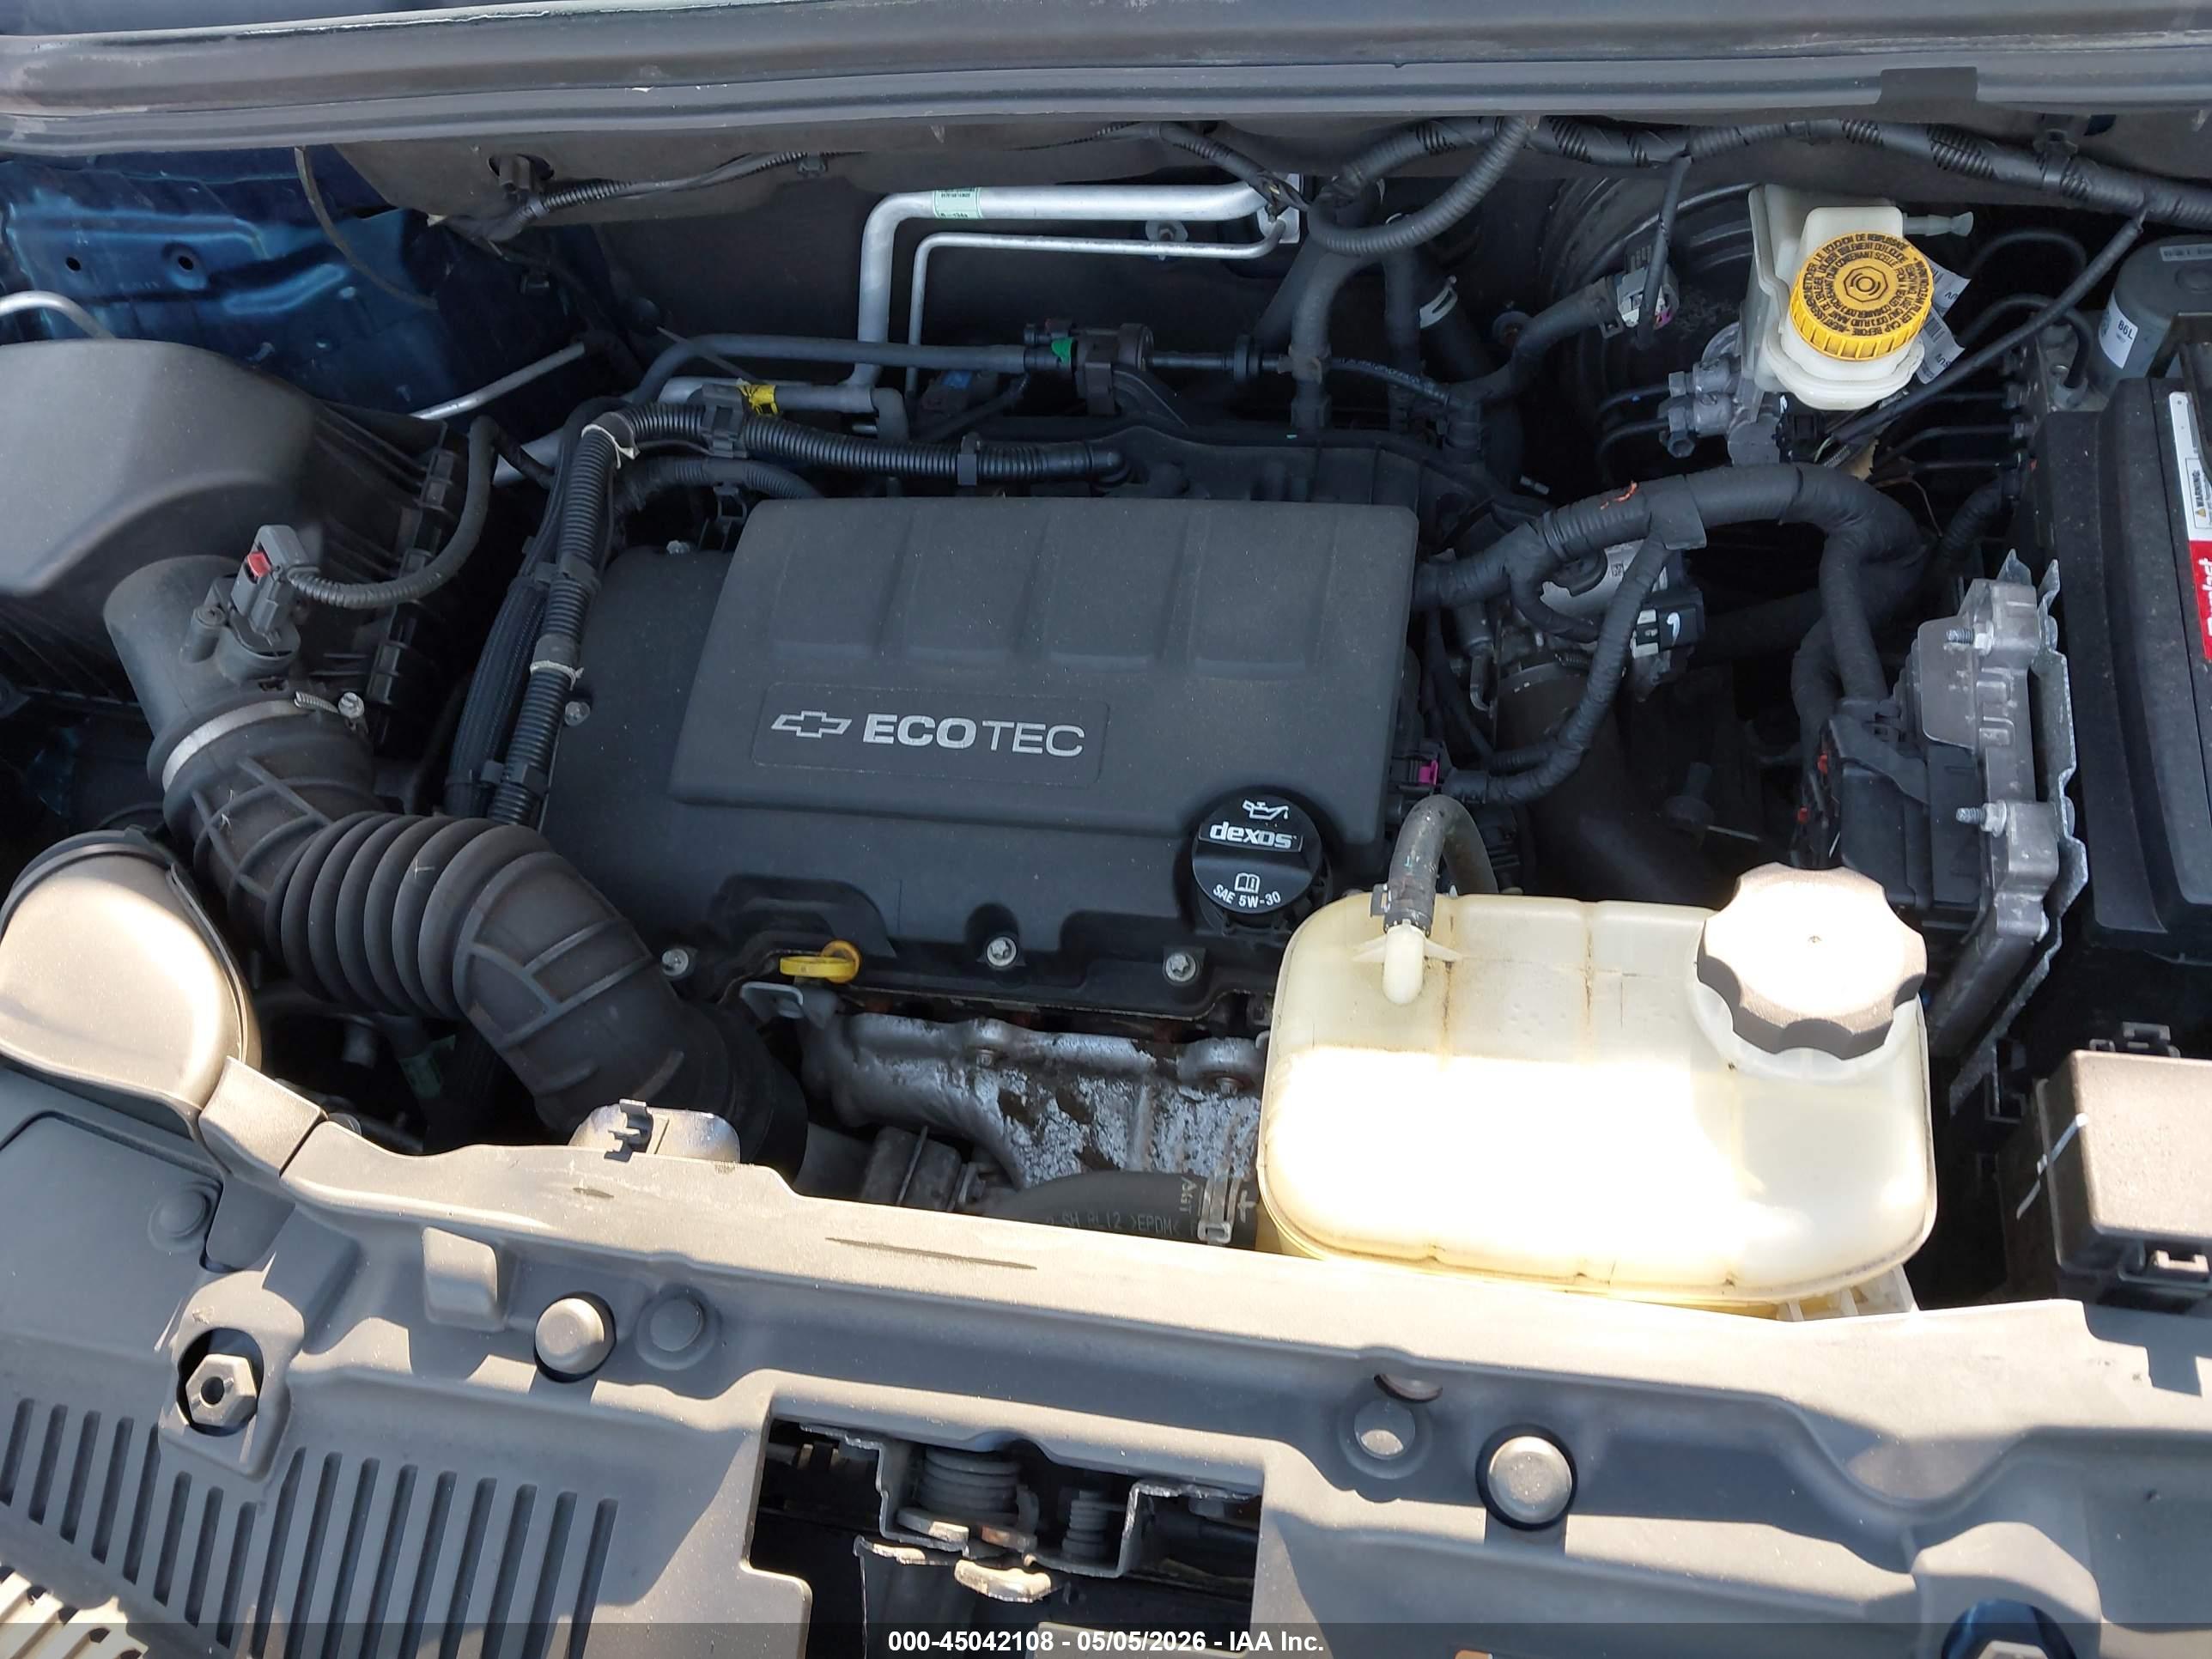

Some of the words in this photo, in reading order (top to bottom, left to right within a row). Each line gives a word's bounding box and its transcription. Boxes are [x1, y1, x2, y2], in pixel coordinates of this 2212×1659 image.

[1854, 233, 1865, 241] DE
[1882, 320, 1903, 334] CAP
[862, 713, 1085, 757] ECOTEC
[1212, 884, 1236, 904] SAE
[1238, 890, 1282, 908] 5W-30
